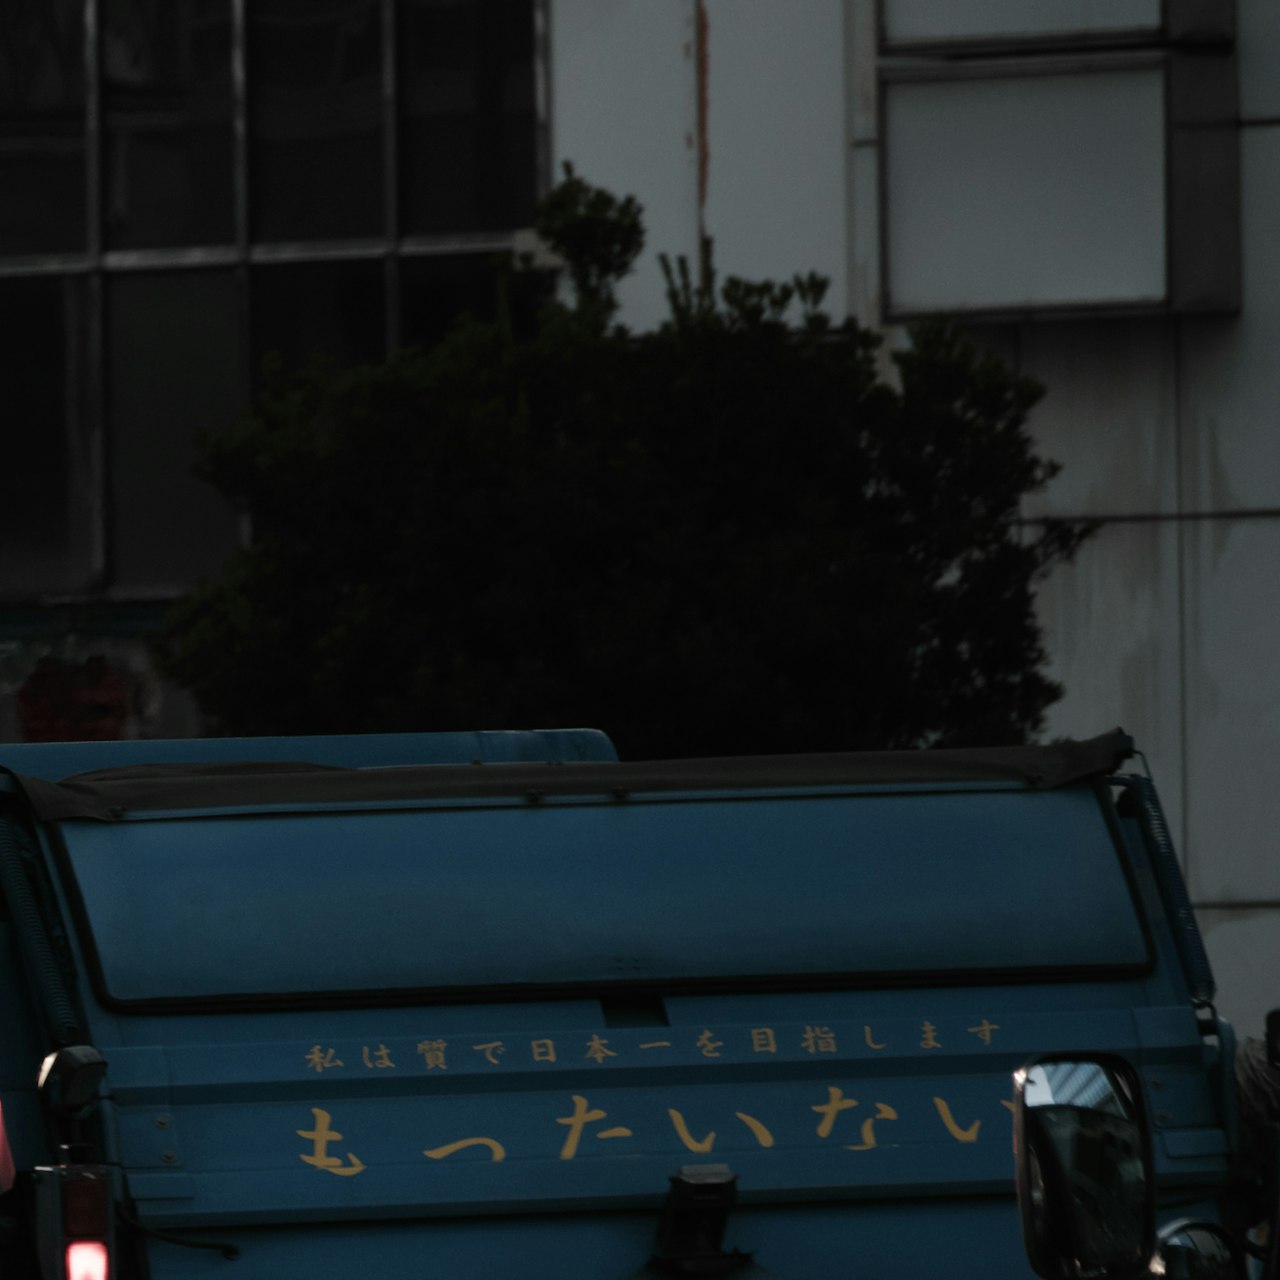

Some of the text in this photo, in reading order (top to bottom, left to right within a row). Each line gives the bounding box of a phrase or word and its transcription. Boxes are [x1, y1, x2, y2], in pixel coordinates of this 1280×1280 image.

[305, 1018, 1000, 1073] 私は質で日本一を目指します
[296, 1086, 1016, 1177] もったいない
